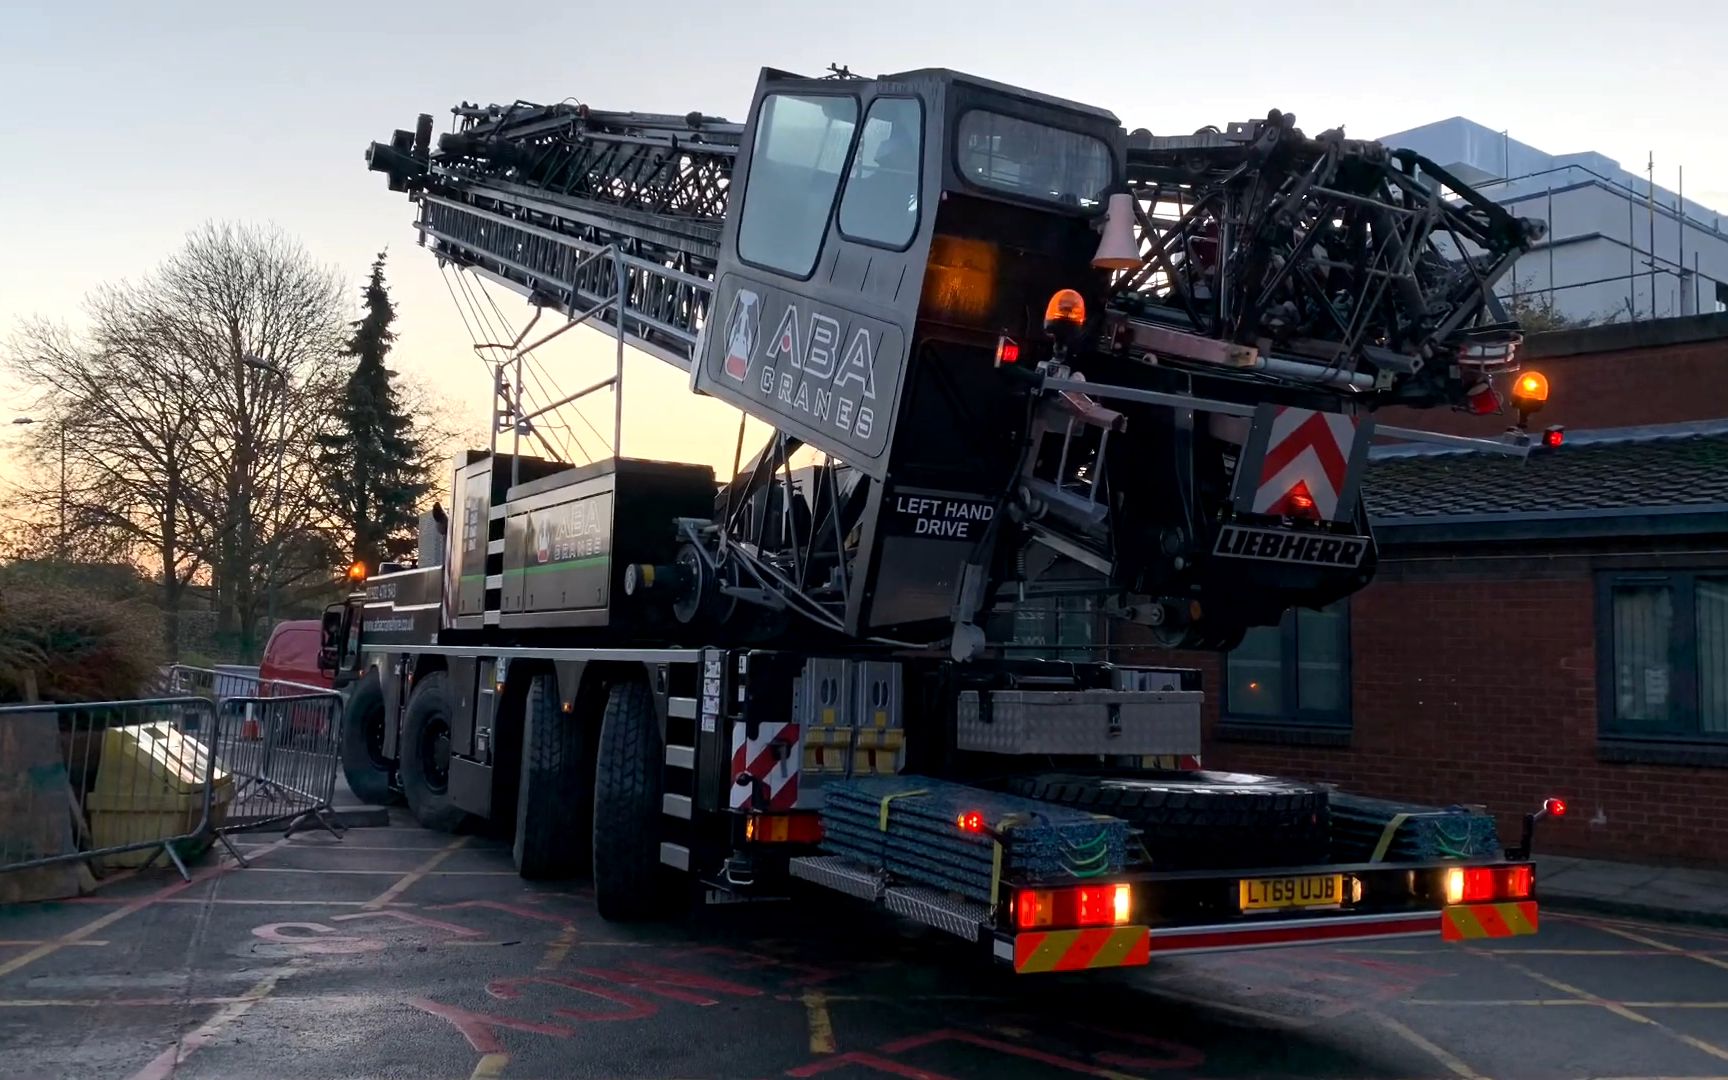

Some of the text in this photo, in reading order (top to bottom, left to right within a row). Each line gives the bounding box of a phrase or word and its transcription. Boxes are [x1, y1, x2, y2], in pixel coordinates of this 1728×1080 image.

[766, 304, 876, 400] ABA
[760, 366, 874, 439] CRANES
[555, 500, 601, 541] ABA
[897, 497, 994, 521] LEFT HAND
[915, 518, 969, 538] DRIVE
[1215, 526, 1365, 566] LIEBHERR
[1247, 877, 1335, 903] LT69 UJB
